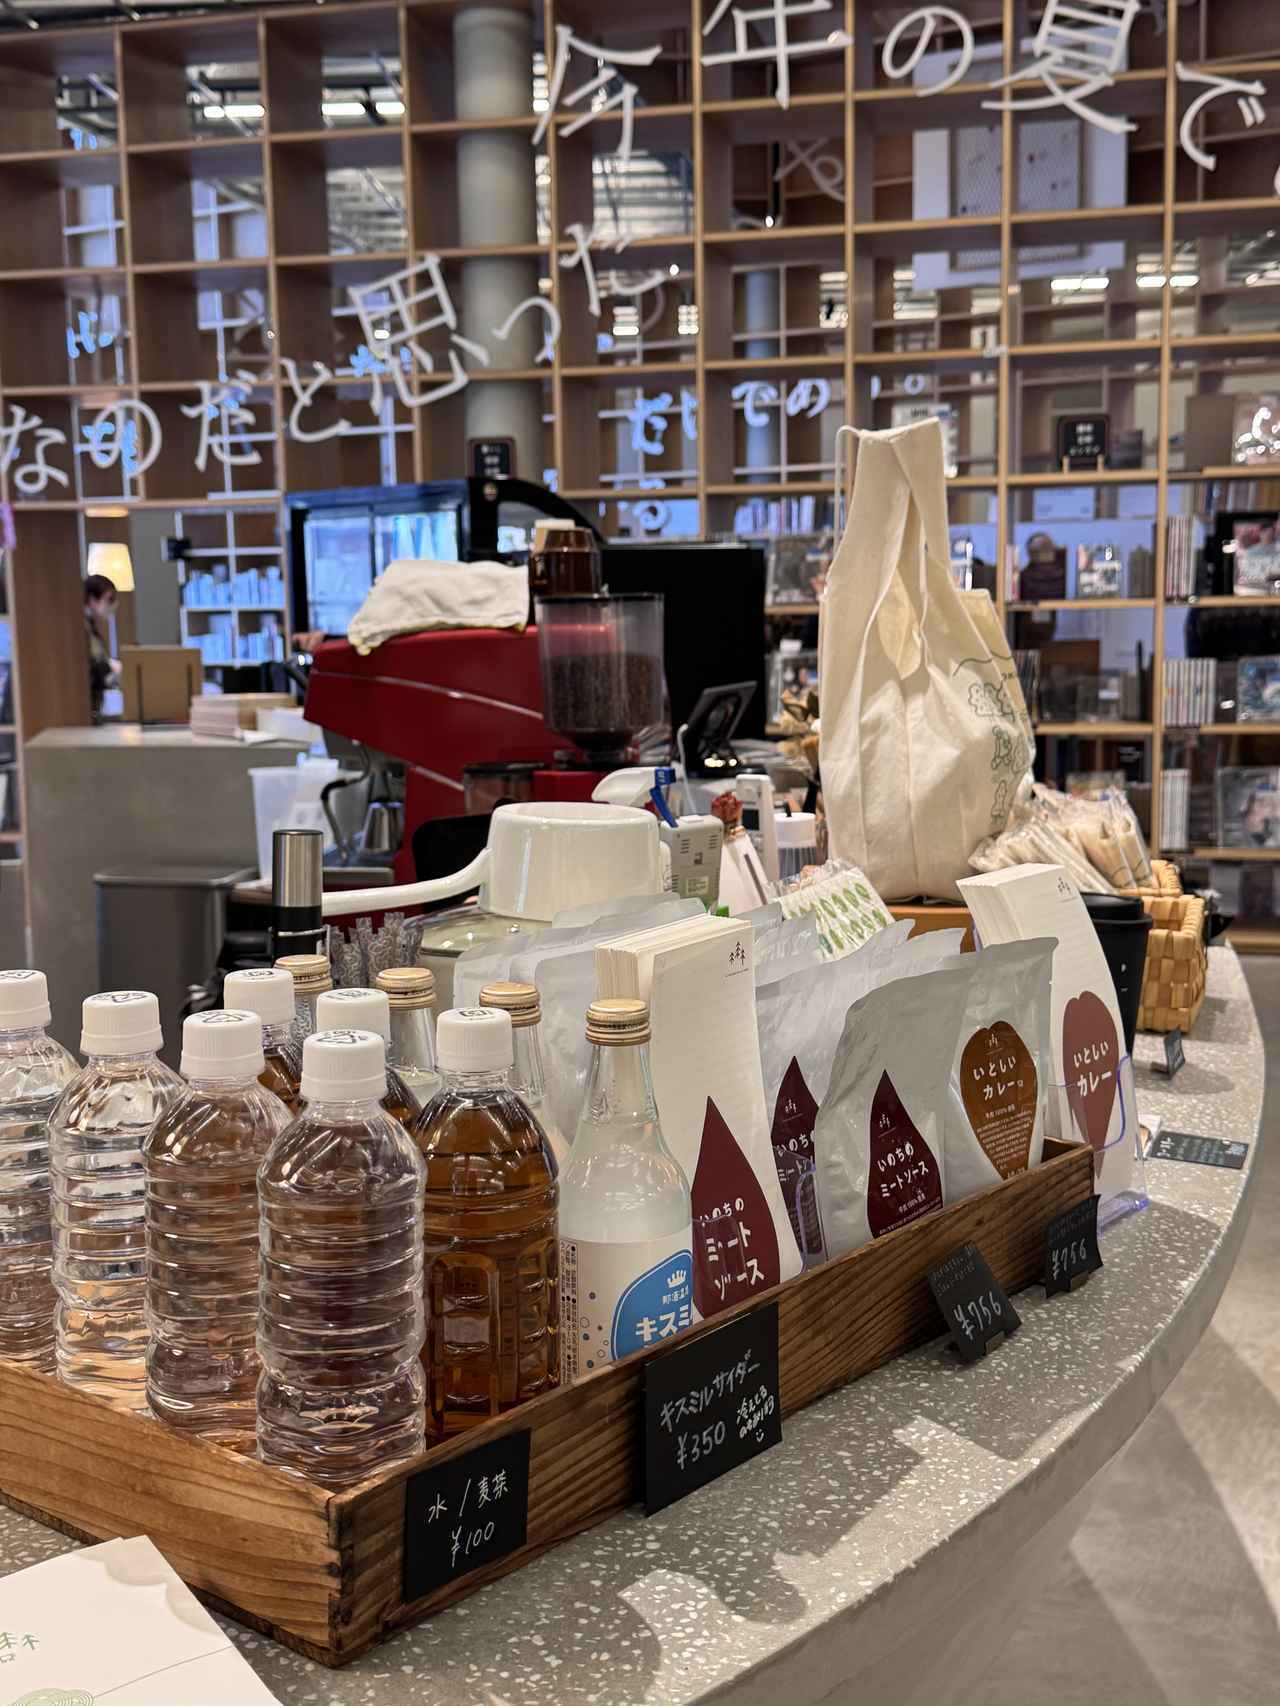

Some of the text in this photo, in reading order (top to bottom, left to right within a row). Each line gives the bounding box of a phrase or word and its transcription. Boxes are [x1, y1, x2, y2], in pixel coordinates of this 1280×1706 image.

[972, 1054, 1017, 1081] いとしい
[1073, 1040, 1109, 1068] いとしい
[1076, 1070, 1113, 1097] カレー
[877, 1141, 914, 1172] いのちの
[880, 1160, 929, 1198] ミートソース
[1052, 1237, 1087, 1280] ¥756
[953, 1291, 1003, 1341] ¥756
[676, 1420, 726, 1471] ¥350
[450, 1521, 496, 1568] ¥100
